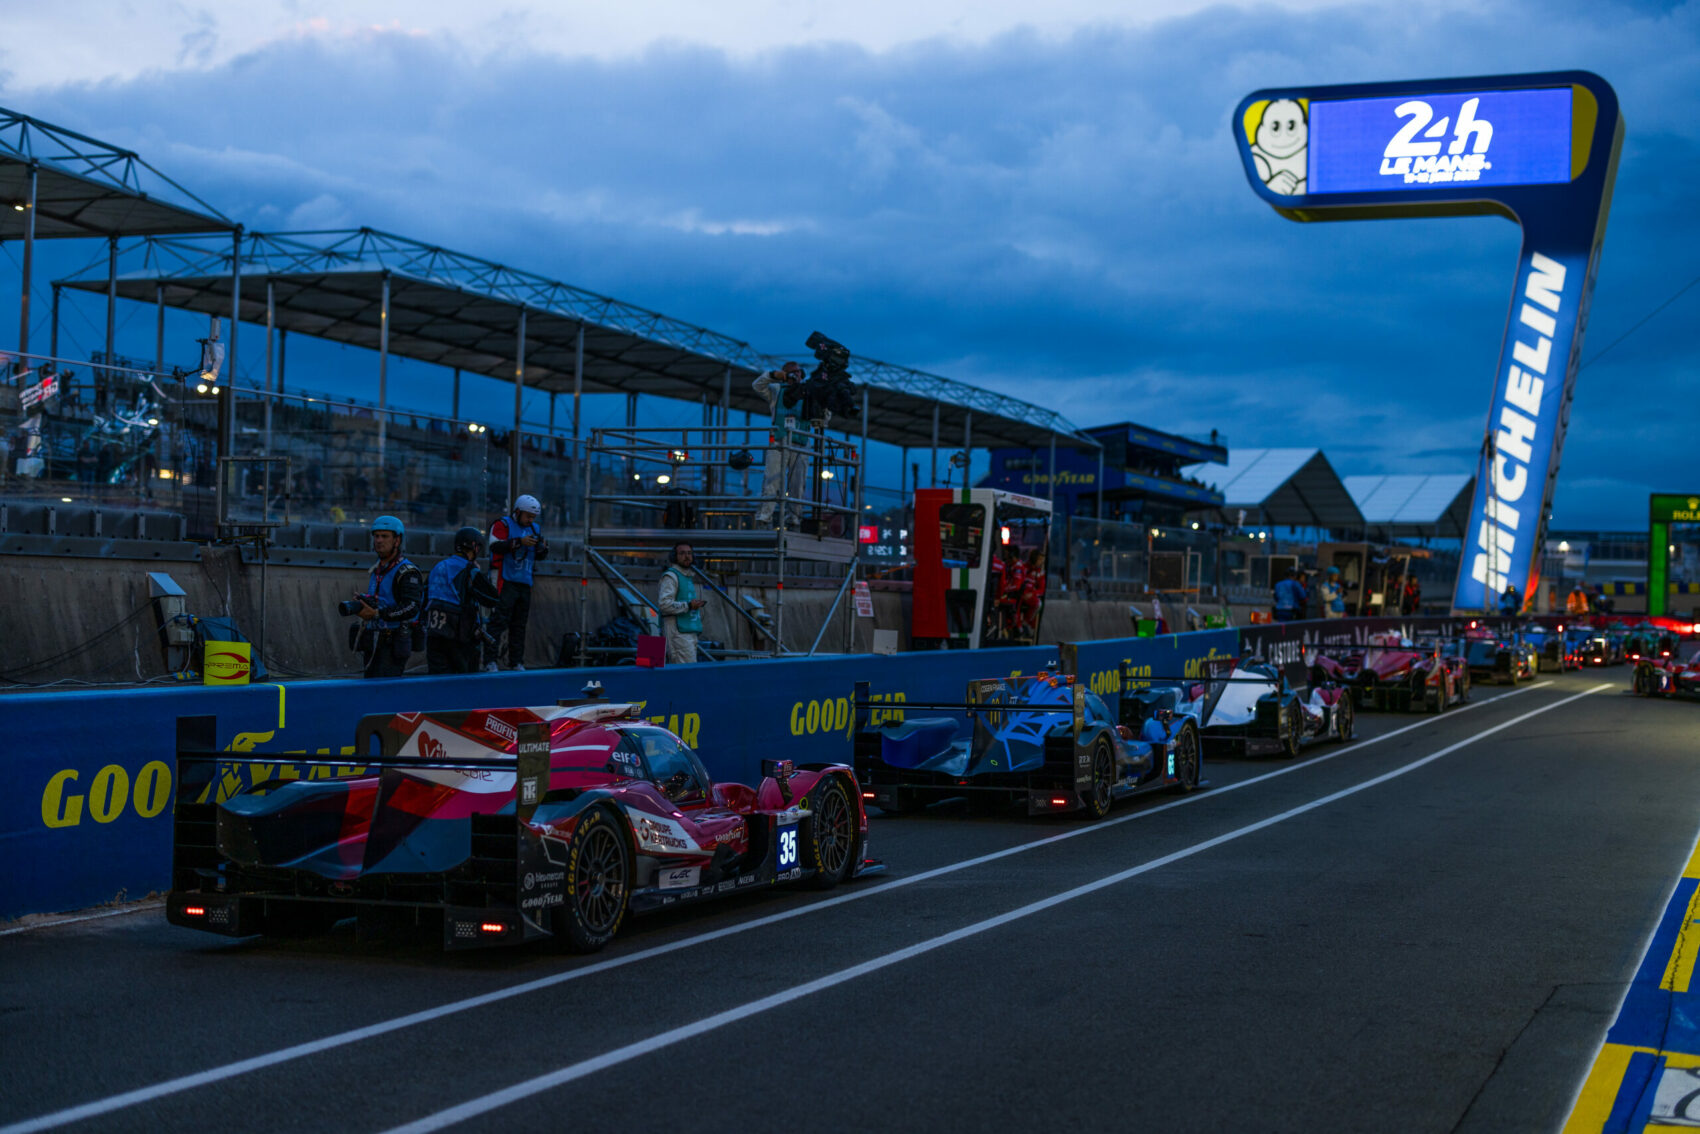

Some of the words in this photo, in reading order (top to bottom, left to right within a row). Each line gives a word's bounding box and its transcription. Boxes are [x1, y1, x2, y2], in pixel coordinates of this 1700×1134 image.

[1383, 97, 1493, 158] 24h
[1379, 157, 1412, 176] LE
[1472, 251, 1567, 595] MICHELIN
[519, 742, 550, 754] ULTIMATE
[612, 751, 630, 763] elf
[779, 831, 798, 866] 35
[522, 893, 564, 909] GOODYEAR
